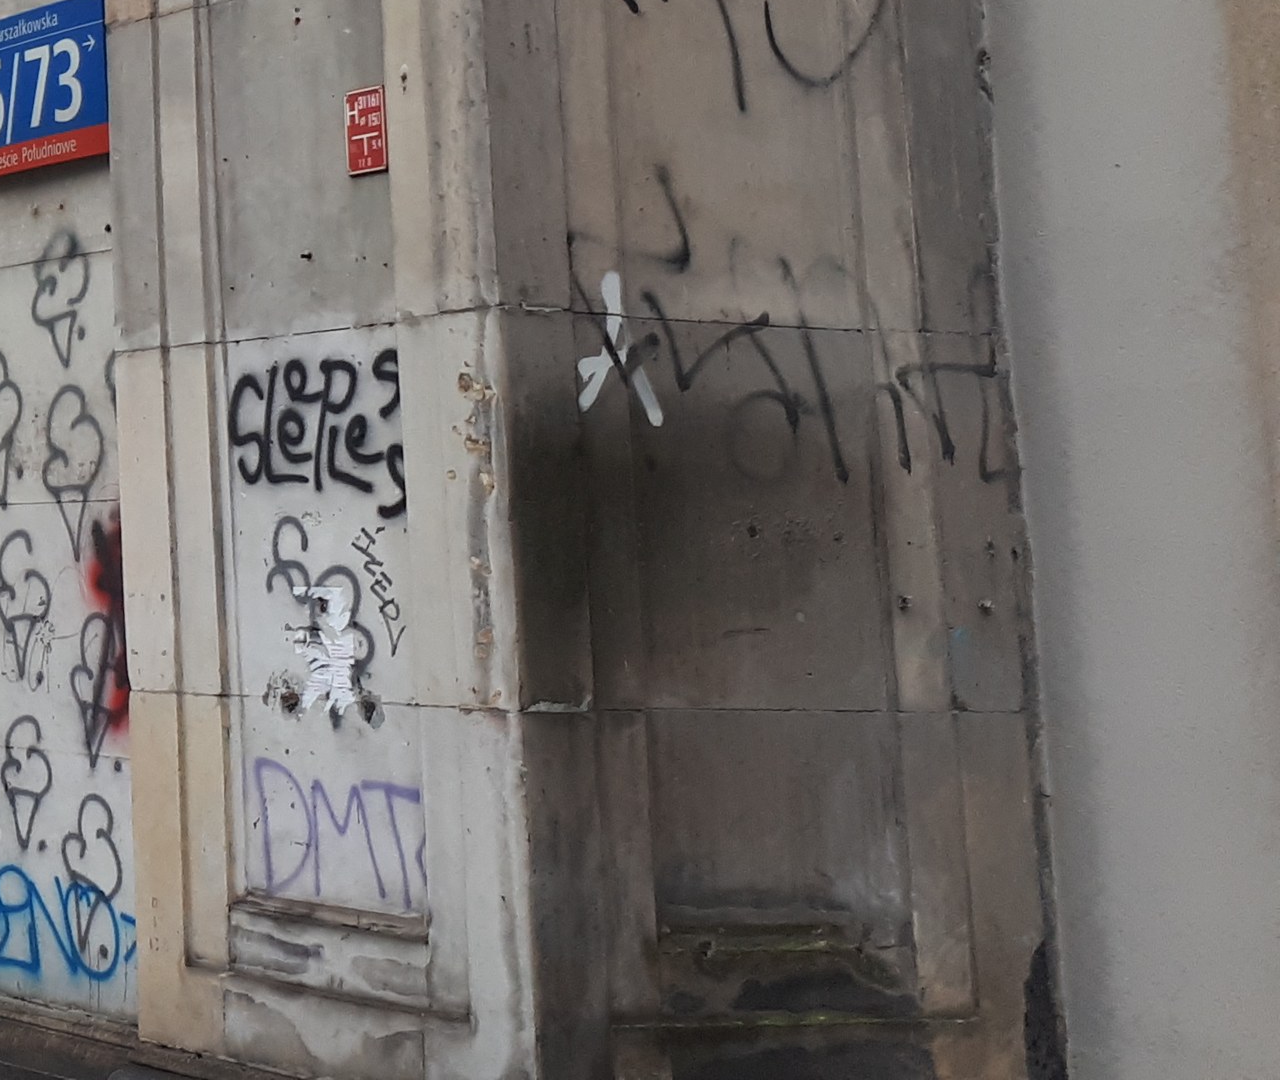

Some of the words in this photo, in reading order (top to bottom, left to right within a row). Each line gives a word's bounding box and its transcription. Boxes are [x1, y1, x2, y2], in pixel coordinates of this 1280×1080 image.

[346, 101, 359, 126] H
[22, 139, 77, 163] Południowe
[351, 131, 379, 156] T
